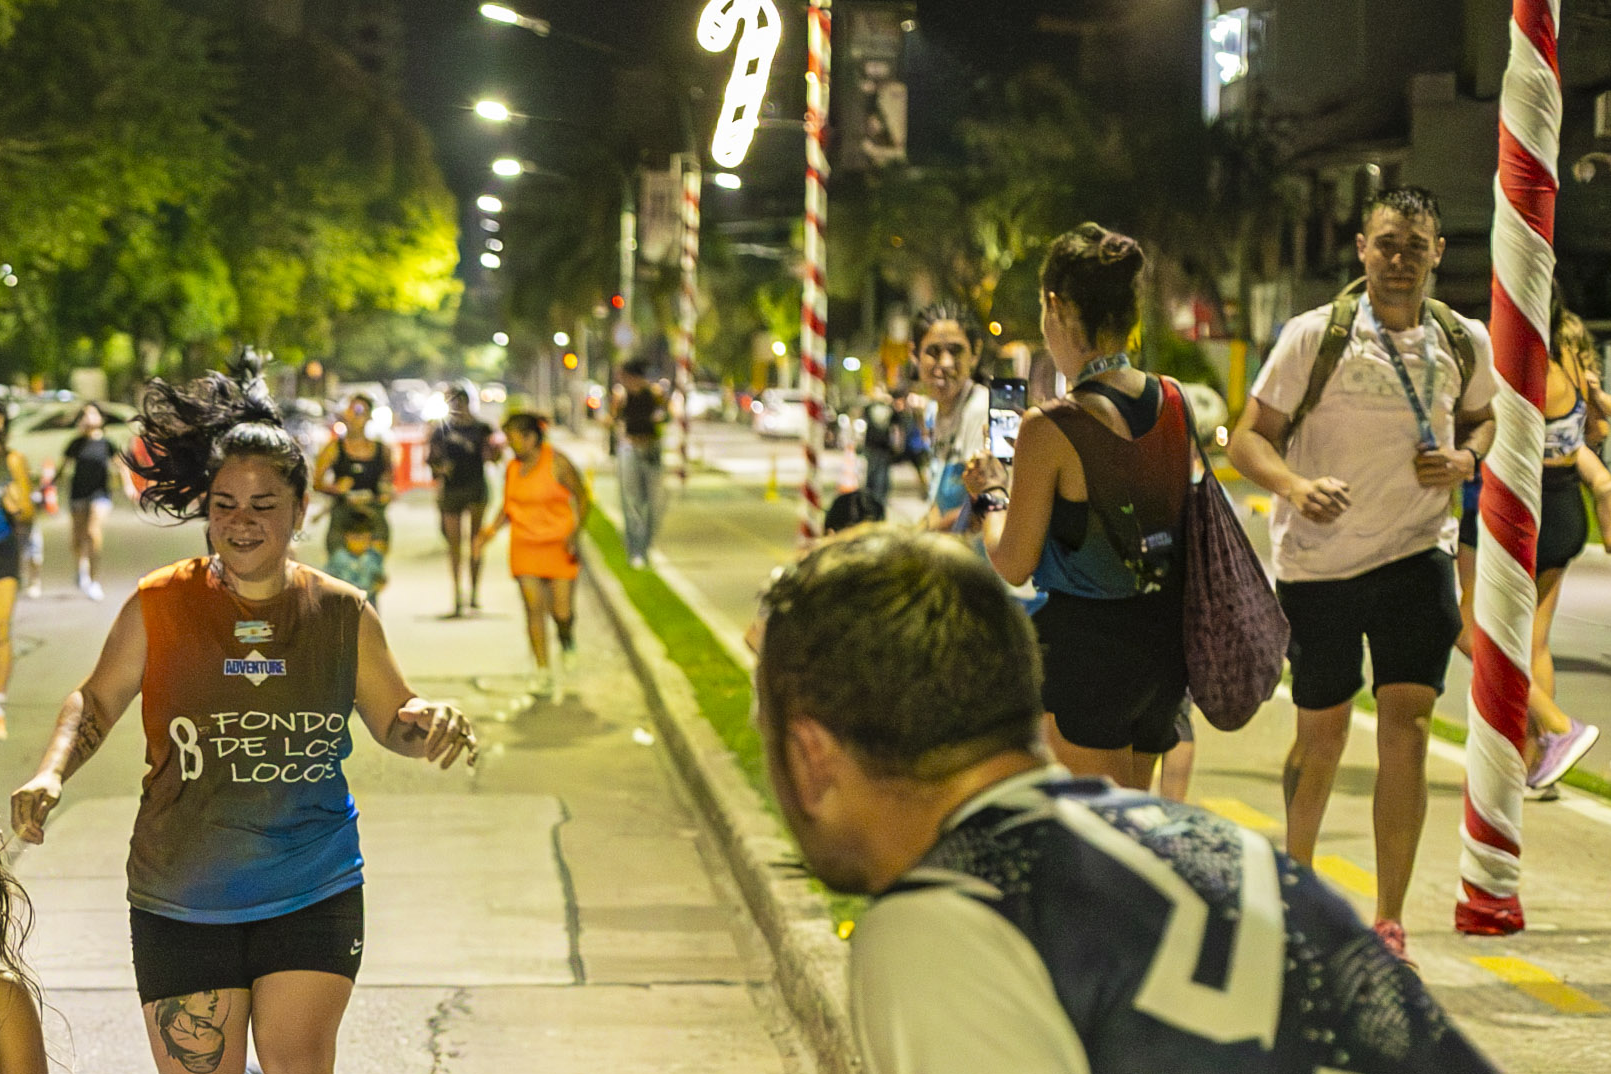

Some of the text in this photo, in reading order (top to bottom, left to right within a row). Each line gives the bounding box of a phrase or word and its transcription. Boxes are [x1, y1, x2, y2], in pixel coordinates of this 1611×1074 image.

[225, 660, 286, 675] ADVENTURE
[210, 710, 345, 735] FONDO
[209, 736, 267, 758] DE
